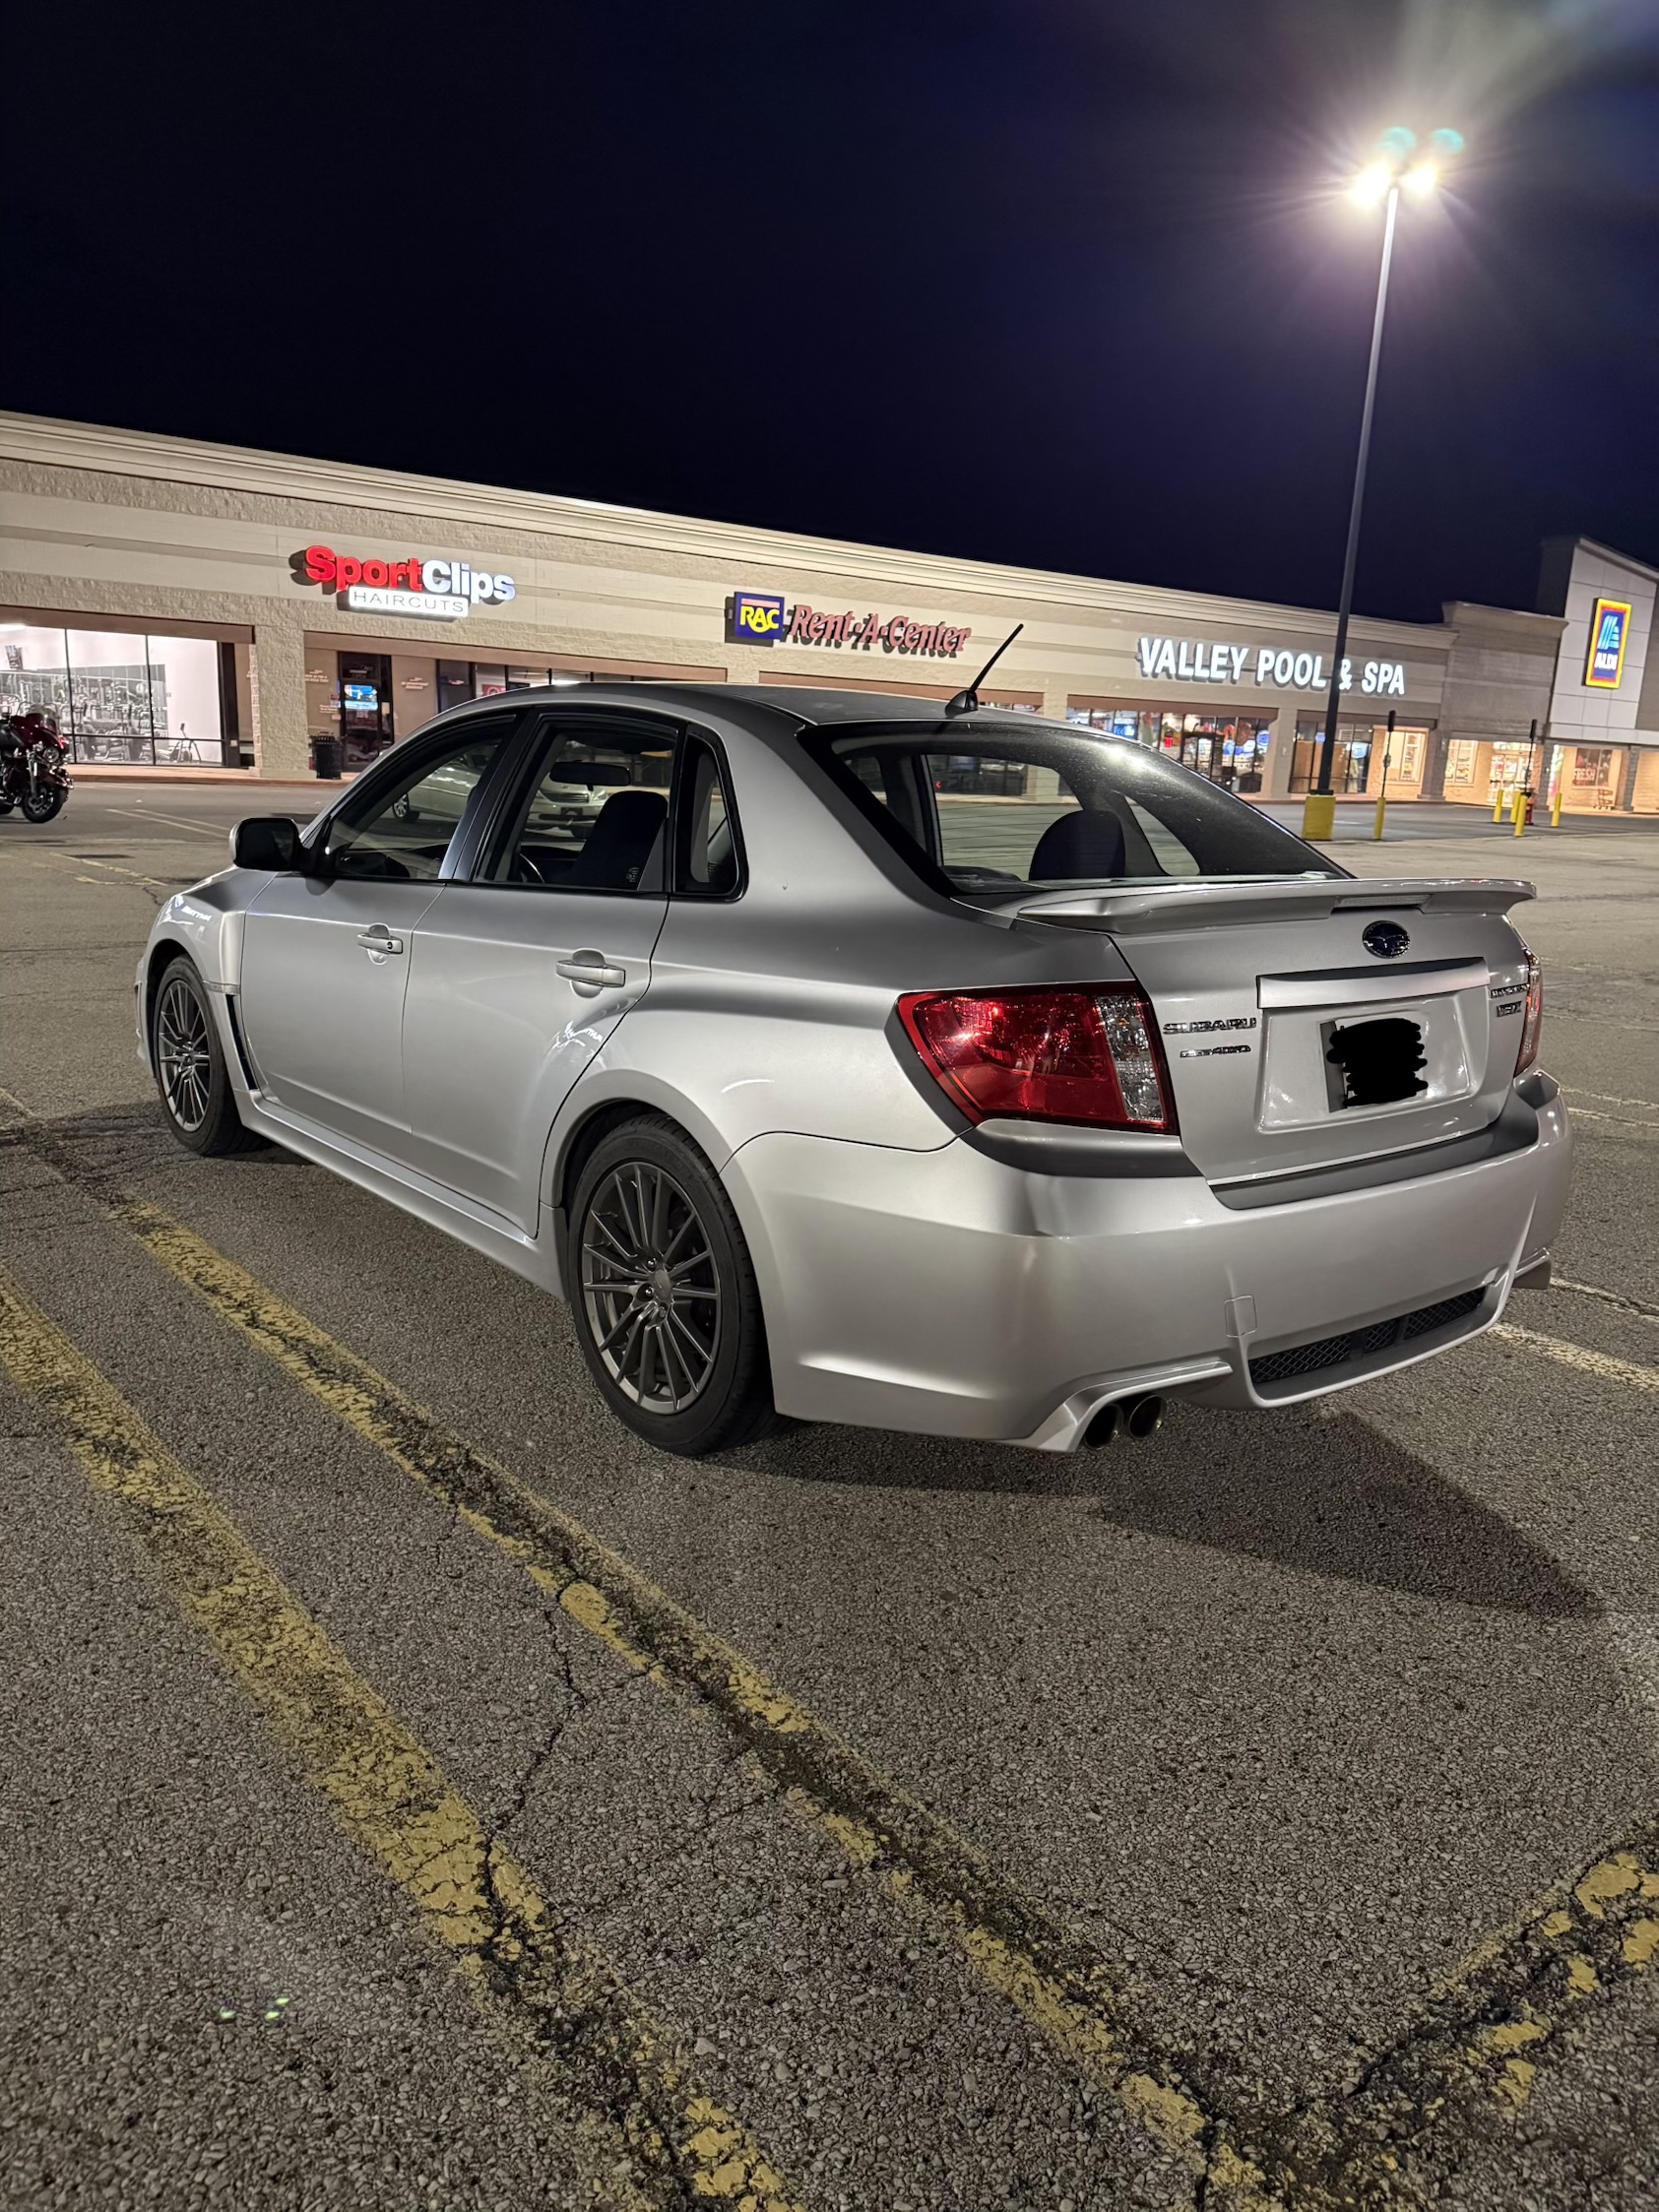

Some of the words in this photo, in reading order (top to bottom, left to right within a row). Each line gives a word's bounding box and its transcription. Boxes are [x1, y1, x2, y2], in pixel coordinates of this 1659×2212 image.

[353, 591, 464, 612] HAIRCUTS
[740, 605, 780, 633] RAC
[1141, 637, 1249, 680] VALLEY
[1257, 649, 1326, 688] POOL
[1339, 659, 1353, 690] &
[1362, 661, 1405, 695] SPA
[1594, 652, 1619, 670] ALDI
[1163, 1017, 1256, 1035] SUBARU
